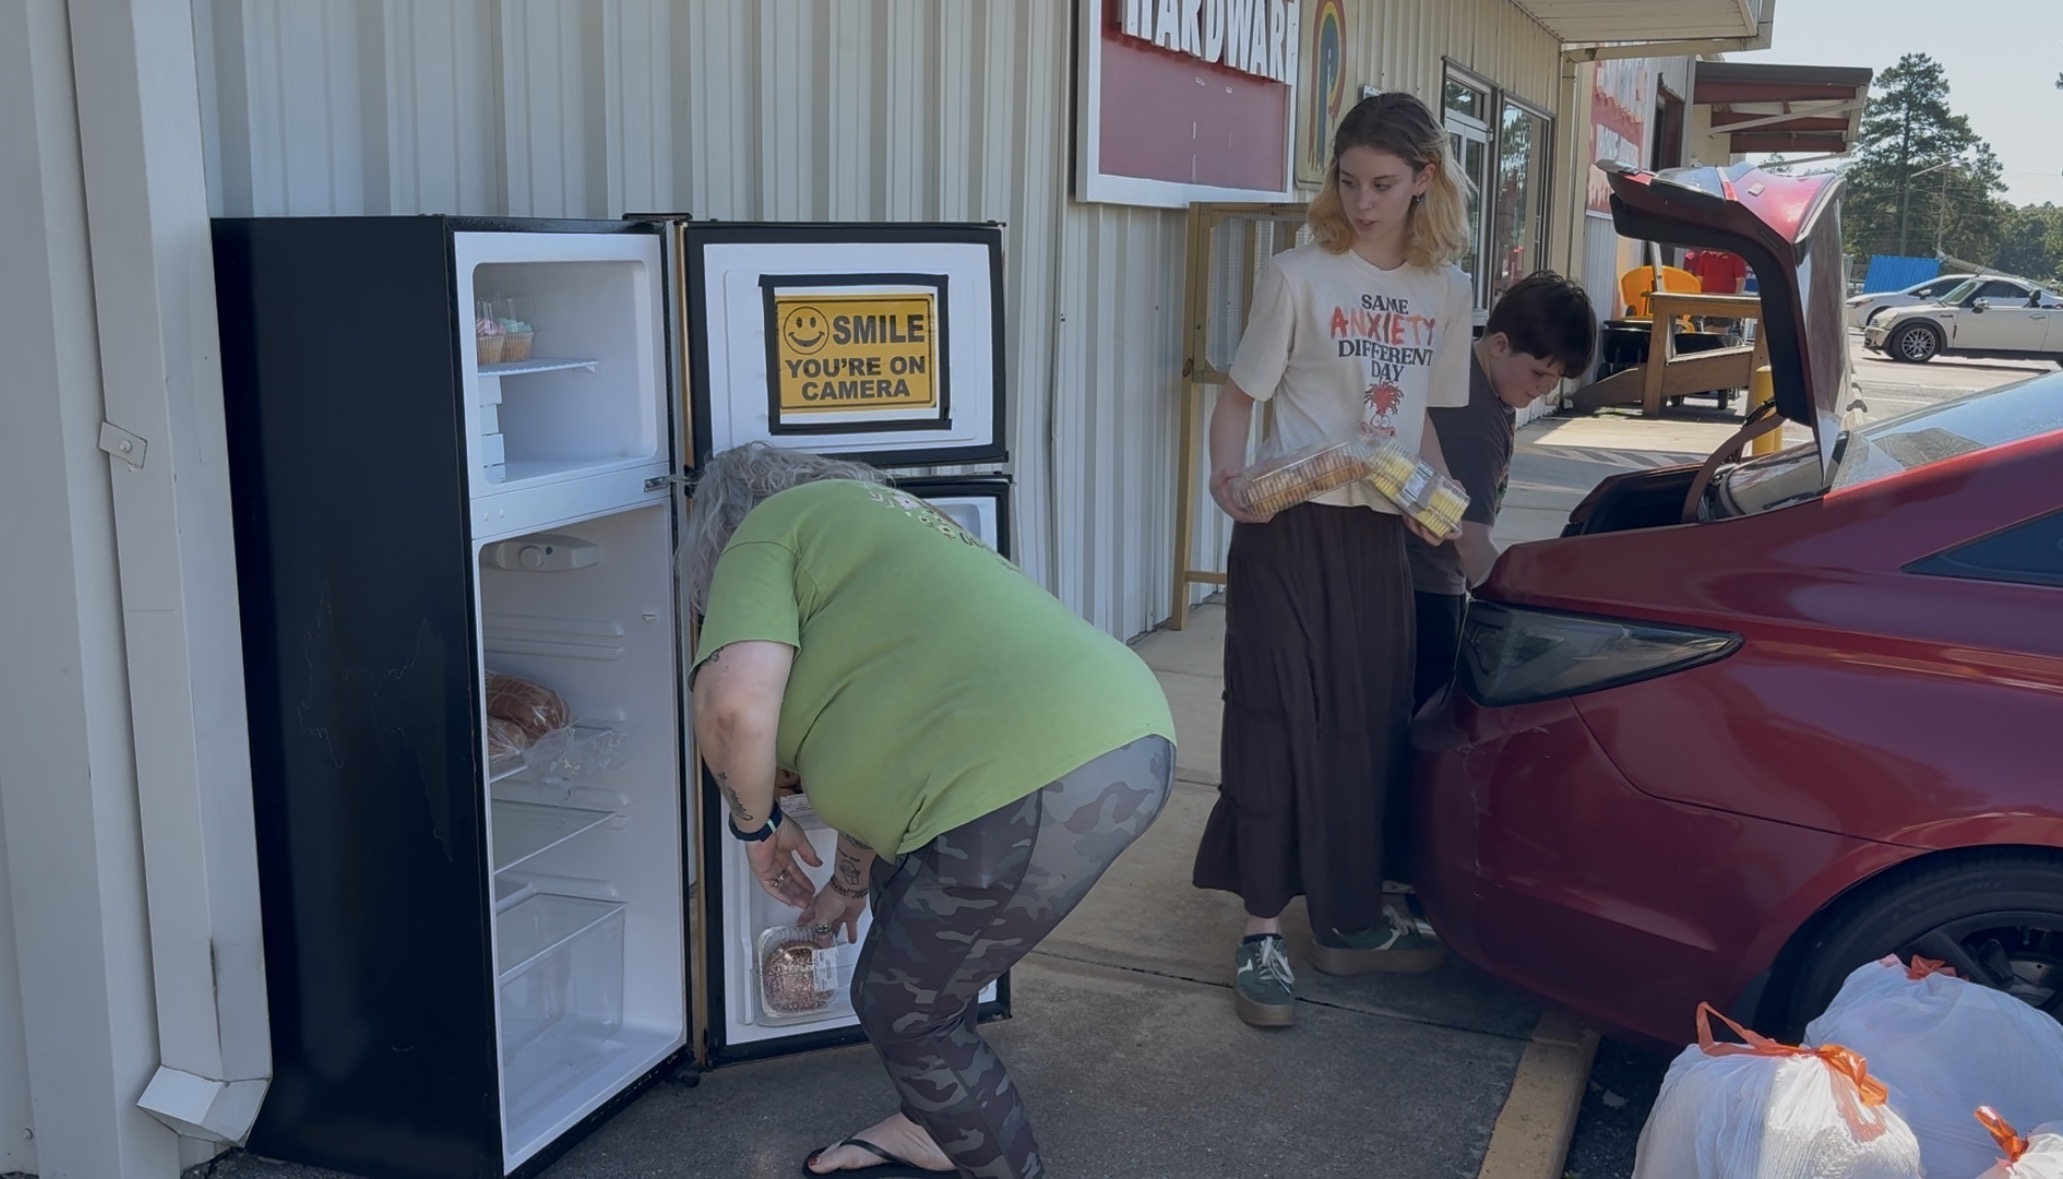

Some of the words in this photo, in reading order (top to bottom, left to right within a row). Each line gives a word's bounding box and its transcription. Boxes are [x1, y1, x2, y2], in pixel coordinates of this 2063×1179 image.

[1361, 294, 1409, 315] SAME
[832, 314, 925, 345] SMILE
[1330, 305, 1435, 347] ANXIETY
[1338, 339, 1434, 367] DIFFERENT
[785, 357, 882, 379] YOU'RE
[889, 356, 926, 375] ON
[1371, 360, 1405, 382] DAY
[801, 379, 911, 401] CAMERA
